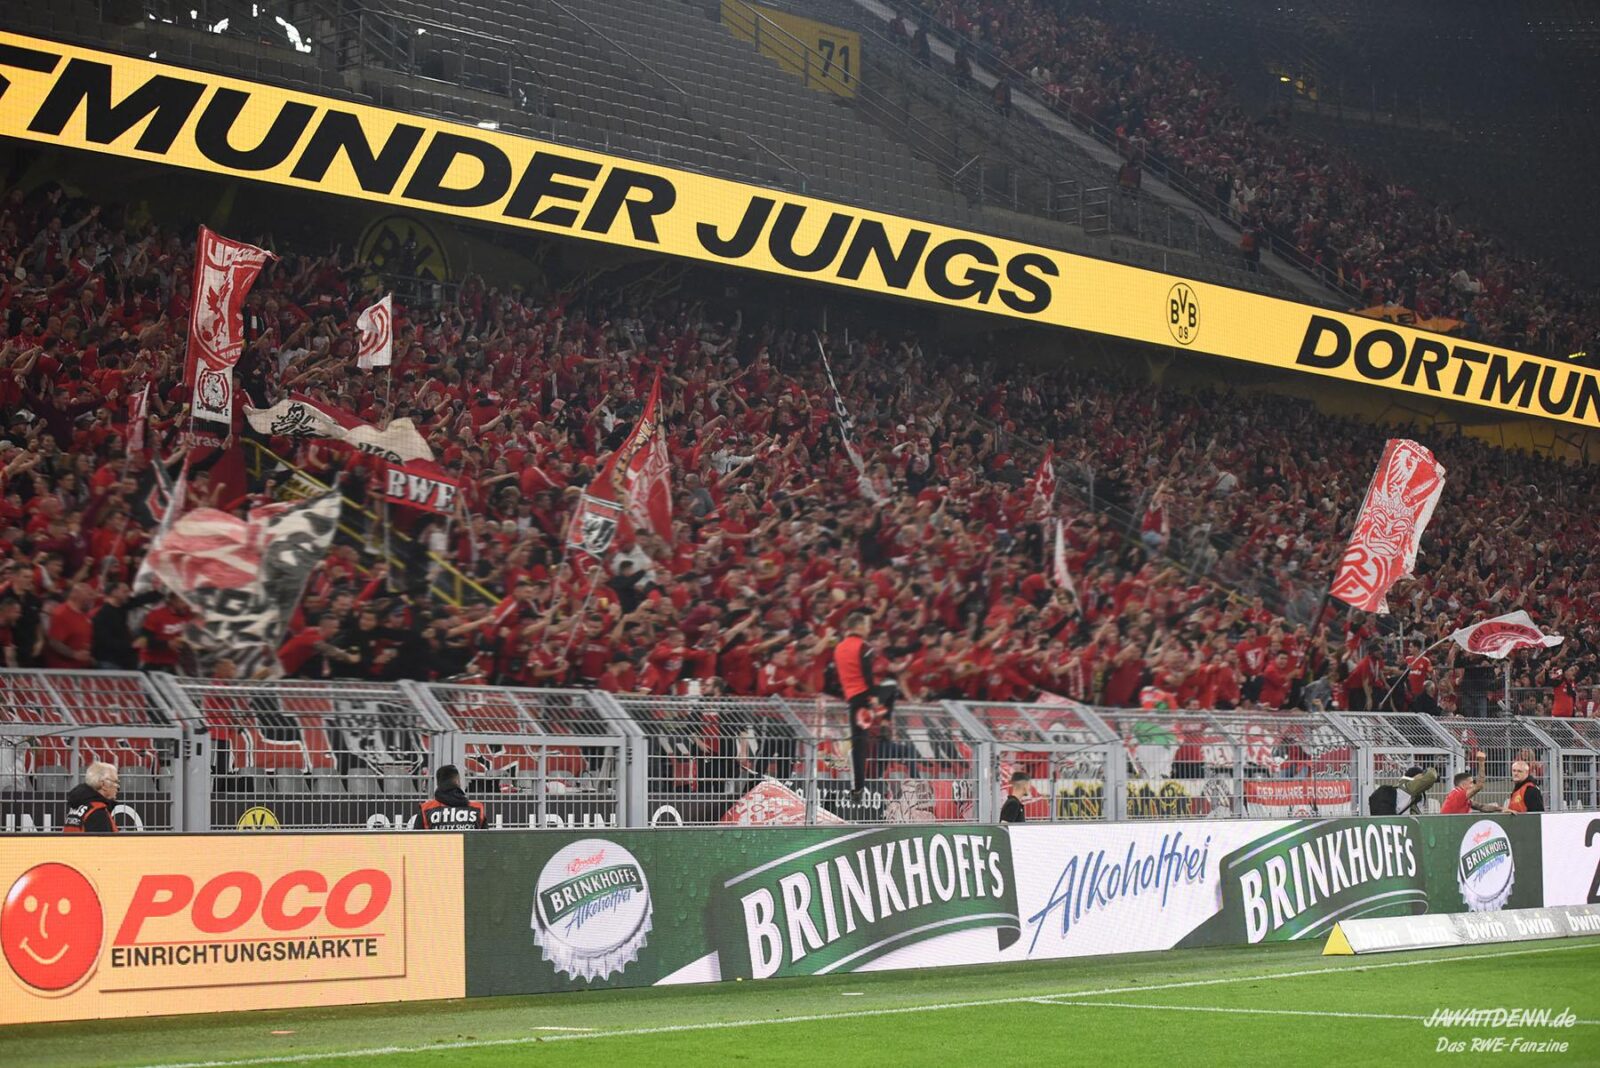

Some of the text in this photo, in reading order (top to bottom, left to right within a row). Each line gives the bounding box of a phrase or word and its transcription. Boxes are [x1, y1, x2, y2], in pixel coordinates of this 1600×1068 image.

[818, 38, 850, 84] 71
[696, 195, 1060, 314] JUNGS
[1171, 288, 1197, 328] BVB
[386, 468, 457, 513] RWE
[430, 807, 478, 824] atlas
[112, 868, 393, 945] POCO
[550, 867, 637, 914] BRINKHOFF's
[741, 834, 1004, 980] BRINKHOFF's
[1028, 831, 1211, 955] Alkoholfrei
[1239, 824, 1417, 944] BRINKHOFF's
[1463, 914, 1508, 940] bwin
[1513, 912, 1556, 936] bwin
[111, 936, 378, 968] EINRICHTUNGSMÄRKTE
